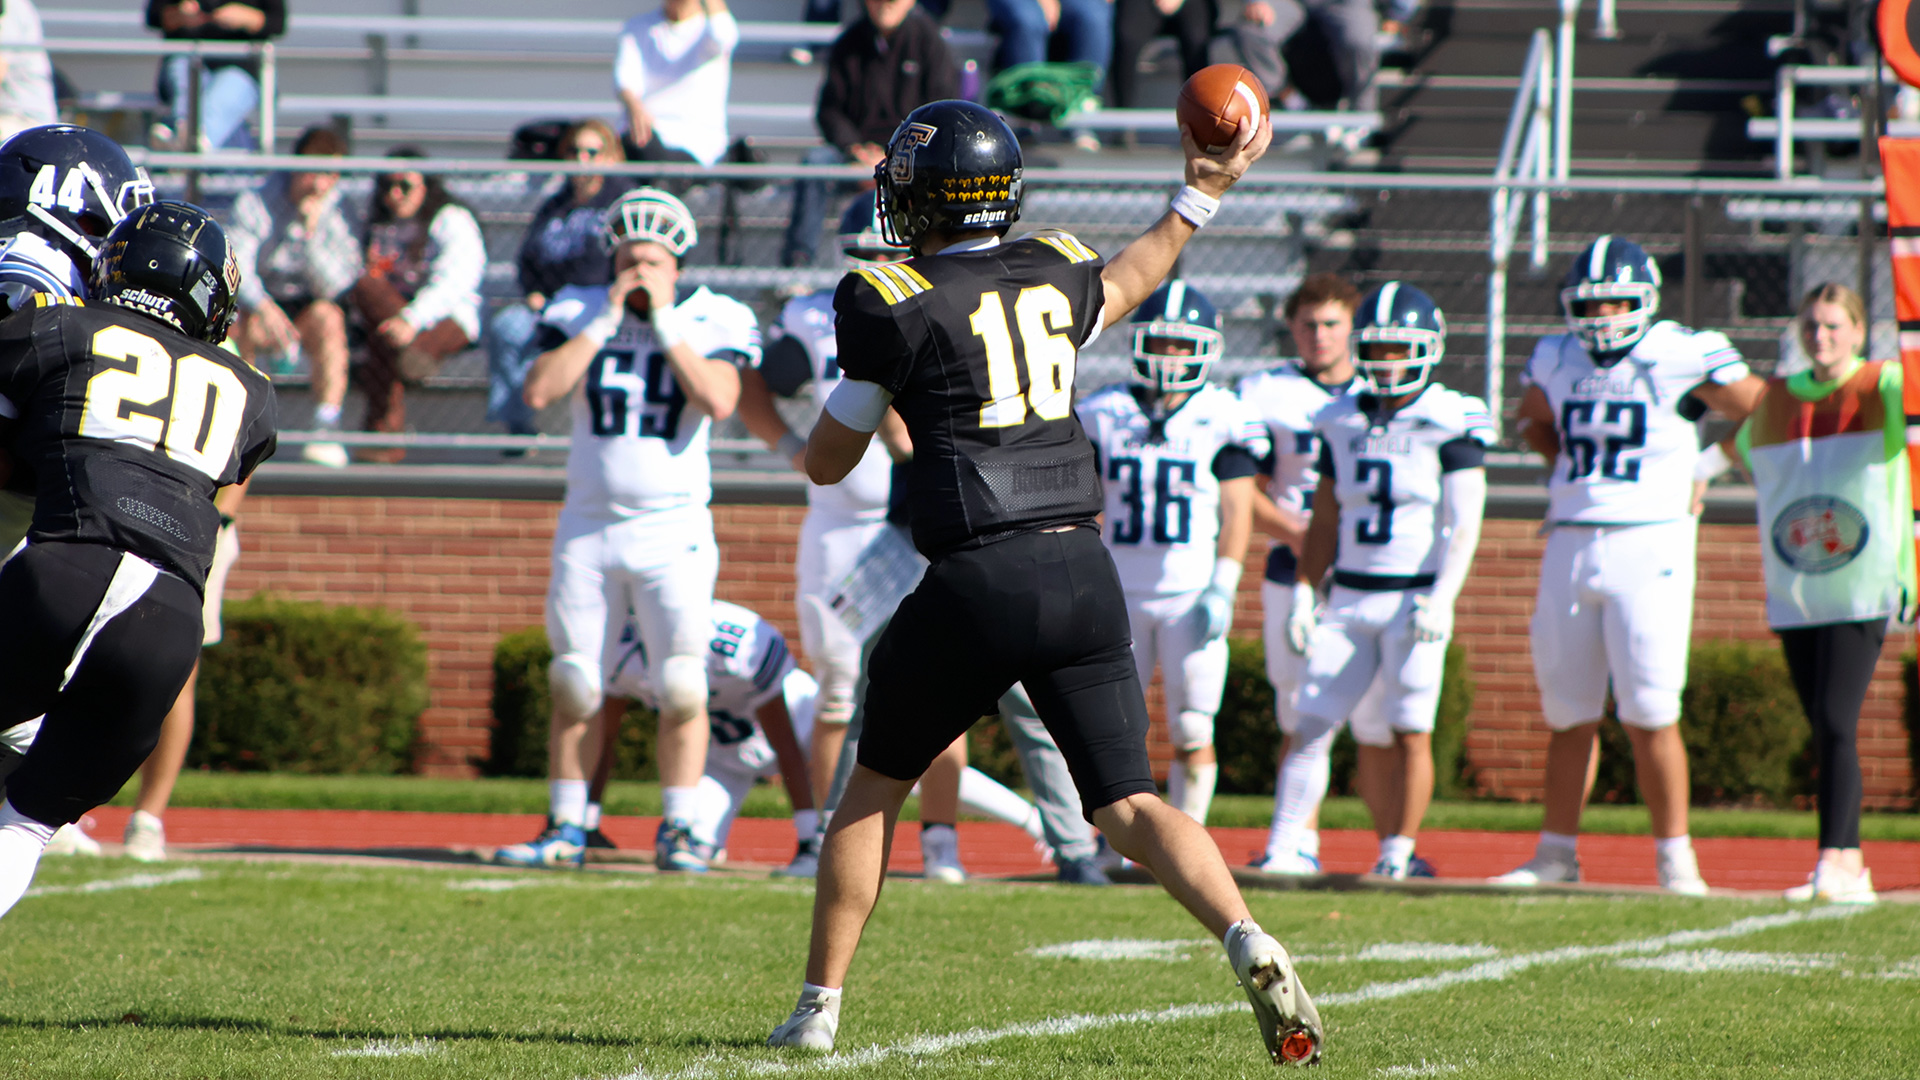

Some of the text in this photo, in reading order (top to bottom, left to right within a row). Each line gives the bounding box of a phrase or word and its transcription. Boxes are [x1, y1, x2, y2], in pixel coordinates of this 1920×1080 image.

[28, 164, 85, 213] 44
[963, 209, 1007, 225] schutt
[119, 287, 173, 312] schutt
[587, 348, 687, 440] 69
[968, 283, 1077, 429] 16
[78, 324, 248, 481] 20
[1562, 400, 1647, 483] 62
[1108, 457, 1196, 545] 36
[1356, 458, 1393, 545] 3
